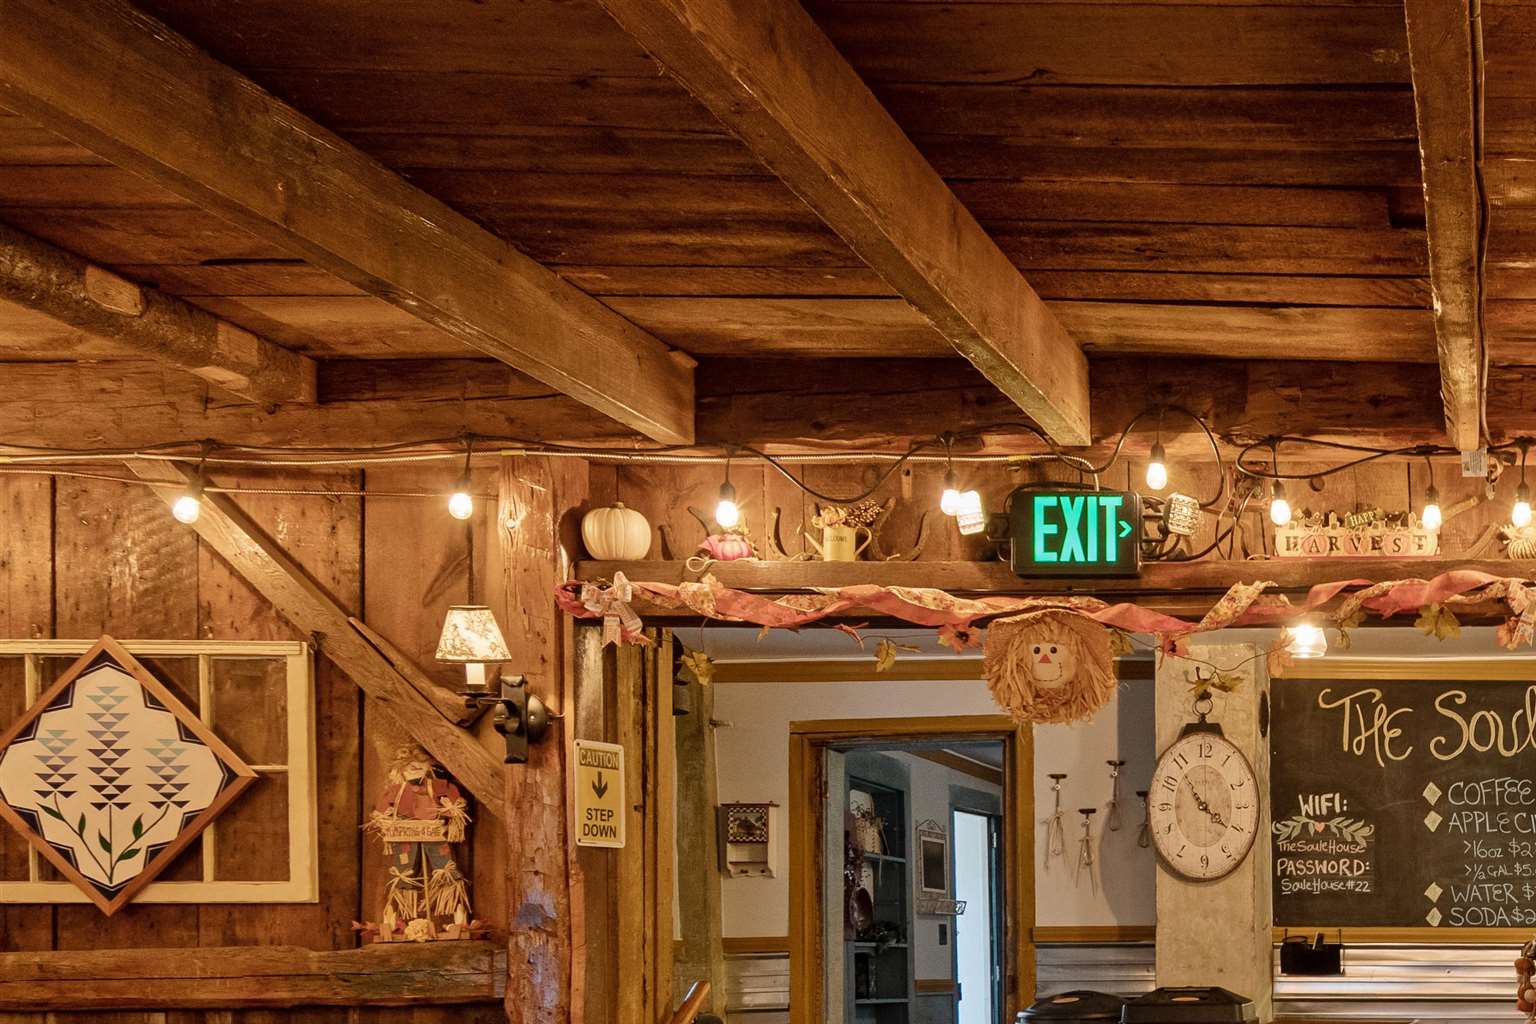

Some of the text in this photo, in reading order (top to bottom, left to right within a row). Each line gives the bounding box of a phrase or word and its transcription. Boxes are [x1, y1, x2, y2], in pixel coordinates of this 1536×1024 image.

[1350, 511, 1374, 527] HAPP
[1034, 496, 1123, 562] EXIT
[1285, 535, 1427, 553] HARVEST
[1318, 688, 1413, 767] THE
[1199, 743, 1213, 758] 12
[580, 750, 619, 769] CAUTION
[1172, 753, 1189, 770] 11
[1221, 754, 1231, 767] 1
[1162, 775, 1178, 792] 10
[1230, 781, 1244, 791] 2
[1448, 777, 1536, 806] COFFEE
[1158, 802, 1172, 812] 9
[1235, 802, 1249, 810] 3
[1298, 792, 1348, 817] WIFI:
[586, 808, 614, 822] STEP
[1448, 811, 1511, 834] APPLE
[583, 823, 617, 838] DOWN
[1176, 844, 1187, 859] 7
[1221, 844, 1233, 860] 5
[1200, 854, 1209, 869] 6
[1277, 858, 1370, 877] PASSWORD:
[1487, 865, 1513, 878] GAL
[1450, 883, 1519, 904] WATER
[1449, 907, 1511, 926] SODA
